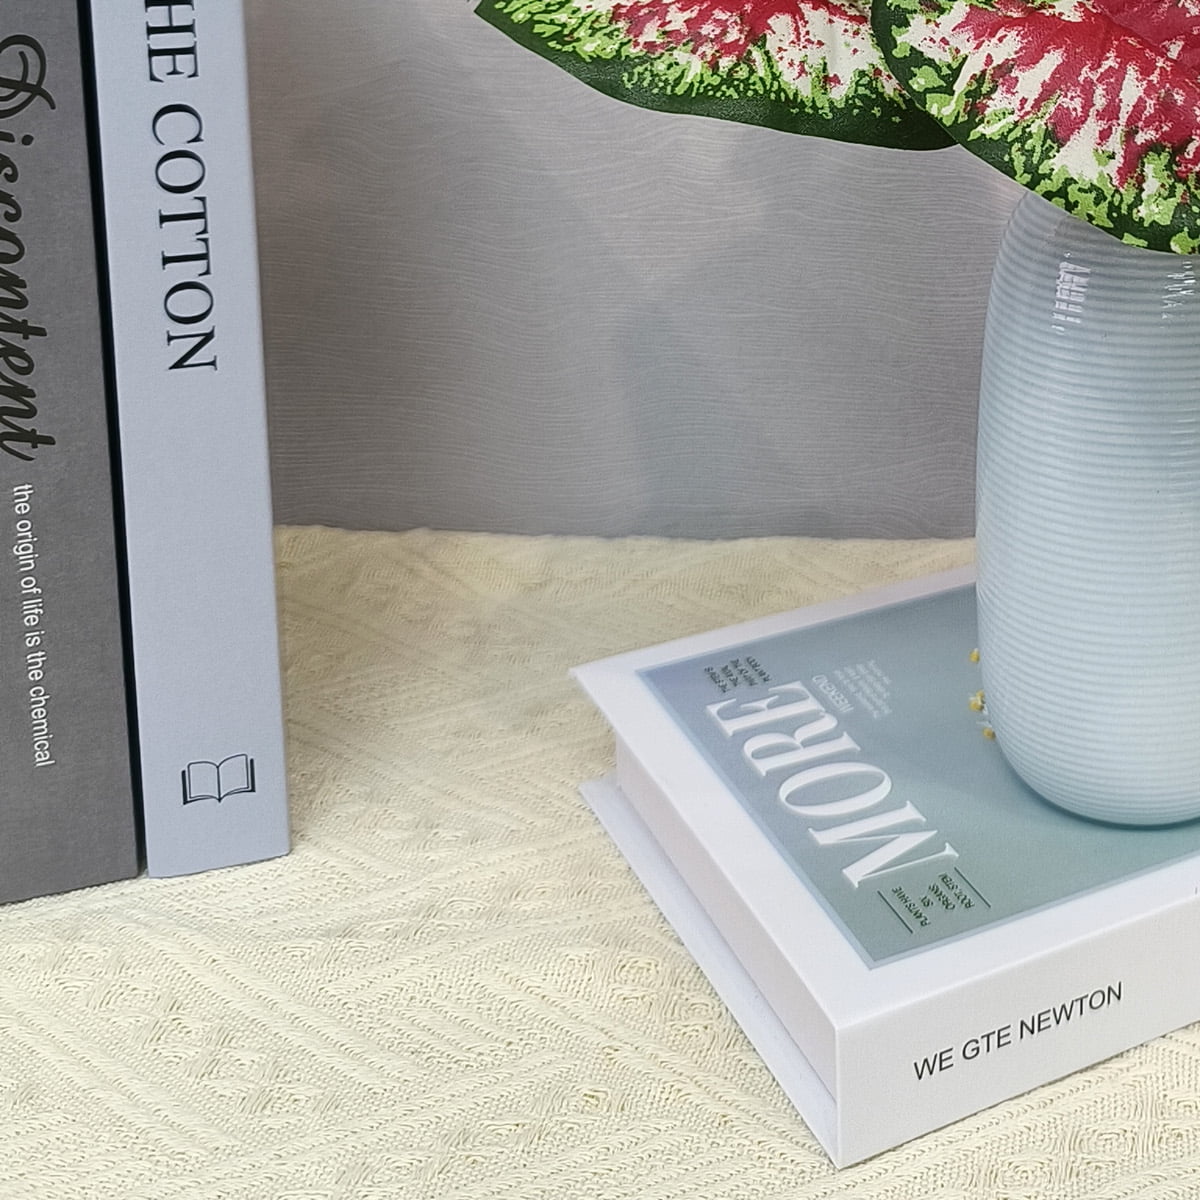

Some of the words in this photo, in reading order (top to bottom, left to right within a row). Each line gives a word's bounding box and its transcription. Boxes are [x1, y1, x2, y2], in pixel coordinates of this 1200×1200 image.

[152, 103, 218, 371] COTTON
[13, 484, 34, 515] the
[13, 520, 38, 571] origin
[20, 576, 42, 595] of
[22, 599, 44, 627] life
[25, 630, 45, 648] is
[26, 651, 47, 681] the
[812, 675, 854, 713] WEEKEND
[29, 686, 55, 767] chemical
[705, 680, 959, 889] MORE
[891, 886, 911, 904] HAVE
[938, 874, 958, 891] STEM
[905, 903, 931, 927] PLANTS
[914, 1048, 954, 1080] WE
[962, 1024, 1012, 1060] GTE
[1019, 981, 1122, 1040] NEWTON
